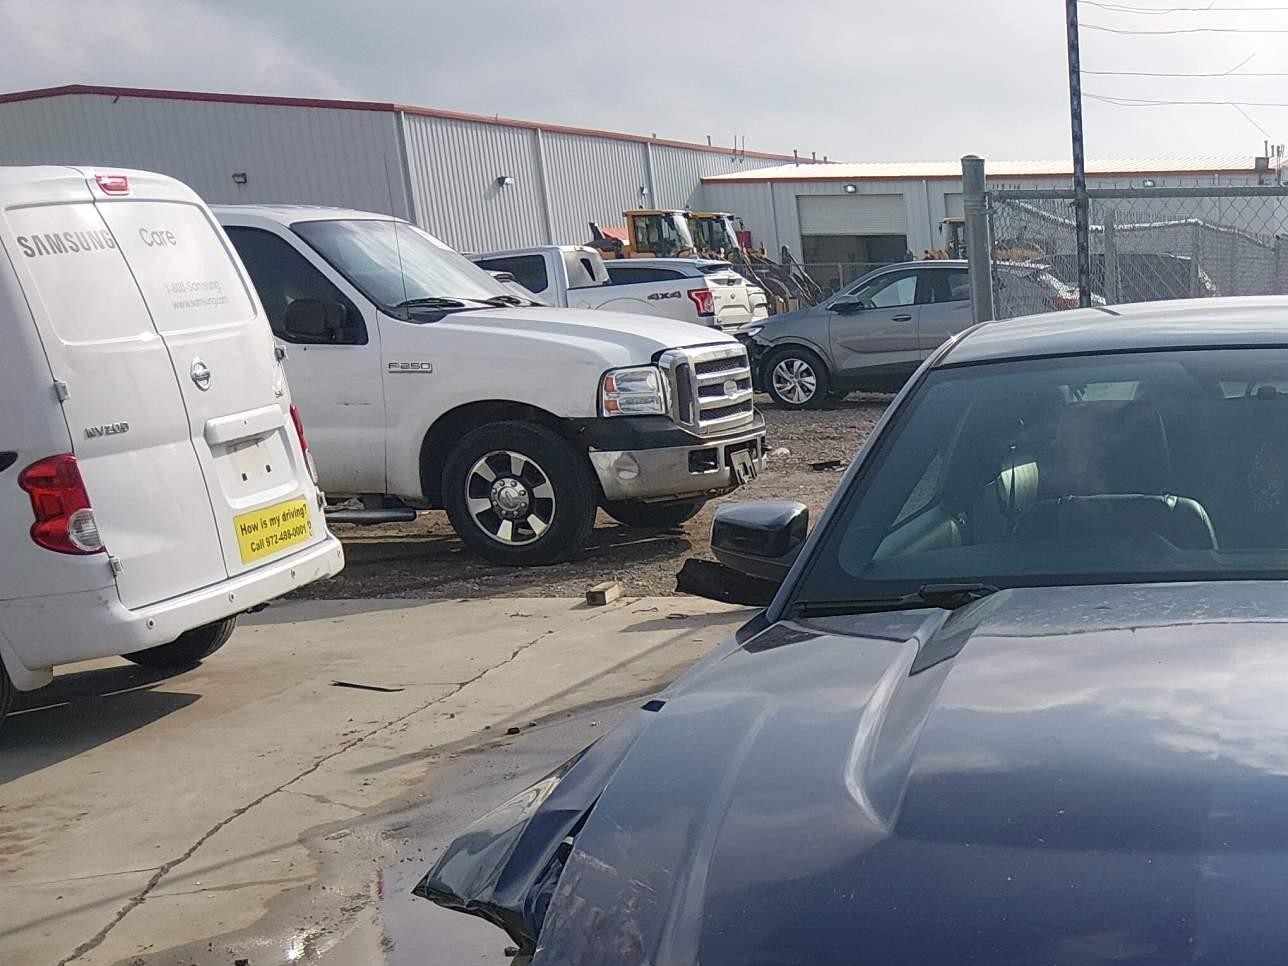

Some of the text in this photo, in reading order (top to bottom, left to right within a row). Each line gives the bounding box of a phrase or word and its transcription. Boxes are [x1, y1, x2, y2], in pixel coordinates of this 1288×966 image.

[17, 228, 177, 258] SAMSUNG Care
[388, 362, 431, 370] F250
[240, 503, 307, 536] How is my driving?
[250, 538, 265, 552] Call
